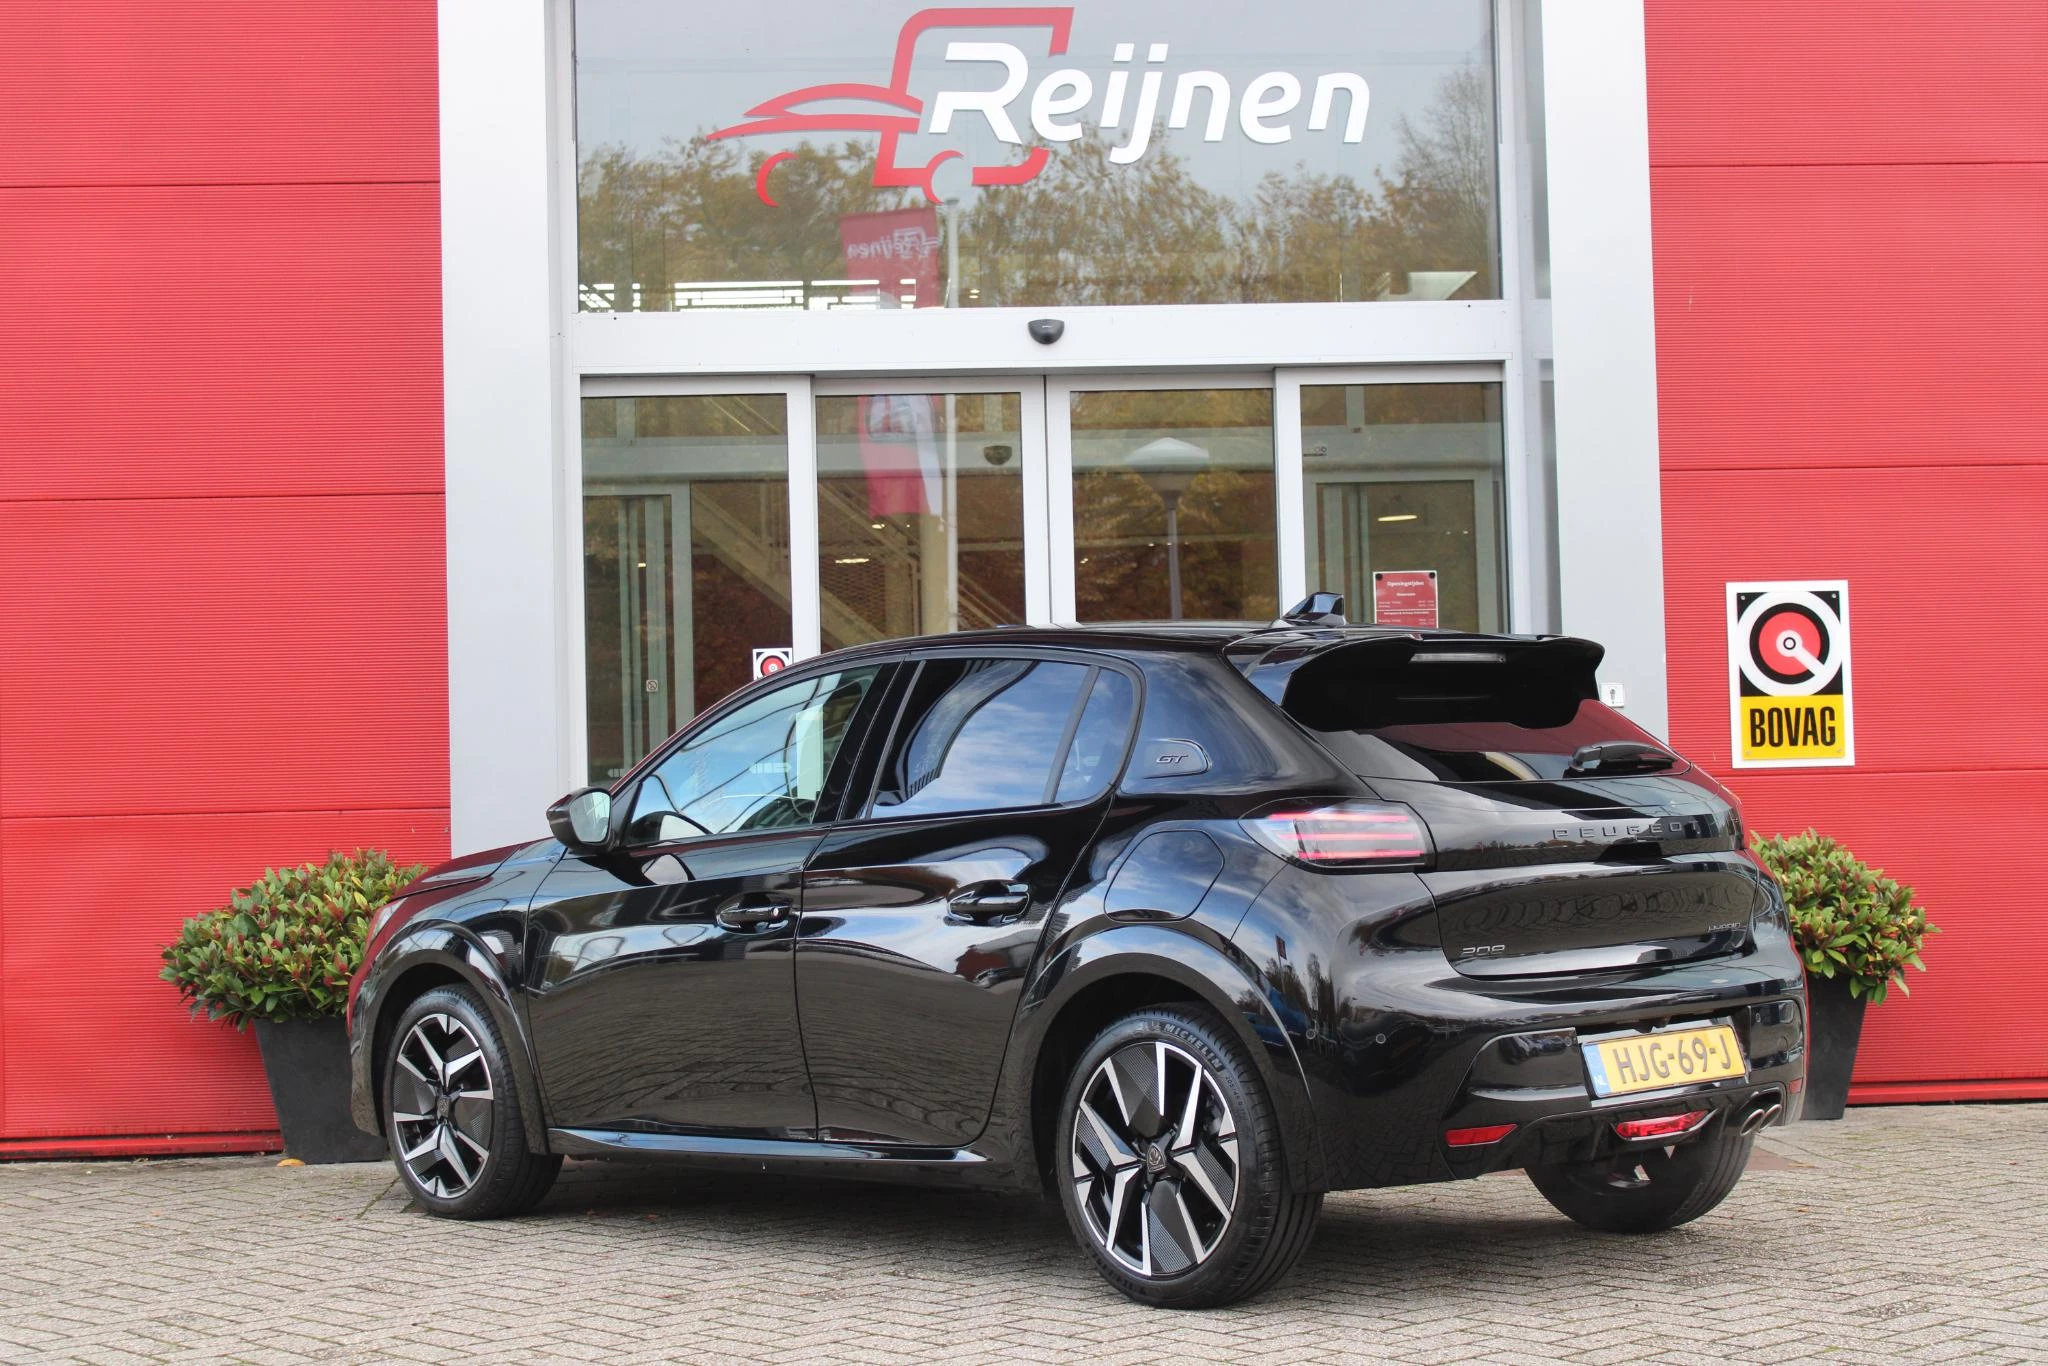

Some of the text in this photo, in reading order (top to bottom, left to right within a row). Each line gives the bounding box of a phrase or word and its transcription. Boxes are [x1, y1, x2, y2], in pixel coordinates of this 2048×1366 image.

[928, 42, 1370, 164] Reijnen
[1749, 706, 1836, 748] BOVAG
[1156, 754, 1189, 763] GT
[1552, 820, 1699, 840] PEUGEOT
[1462, 944, 1505, 956] 208
[1164, 1023, 1223, 1070] MICHELIN
[1612, 1034, 1732, 1084] HJG-69-J
